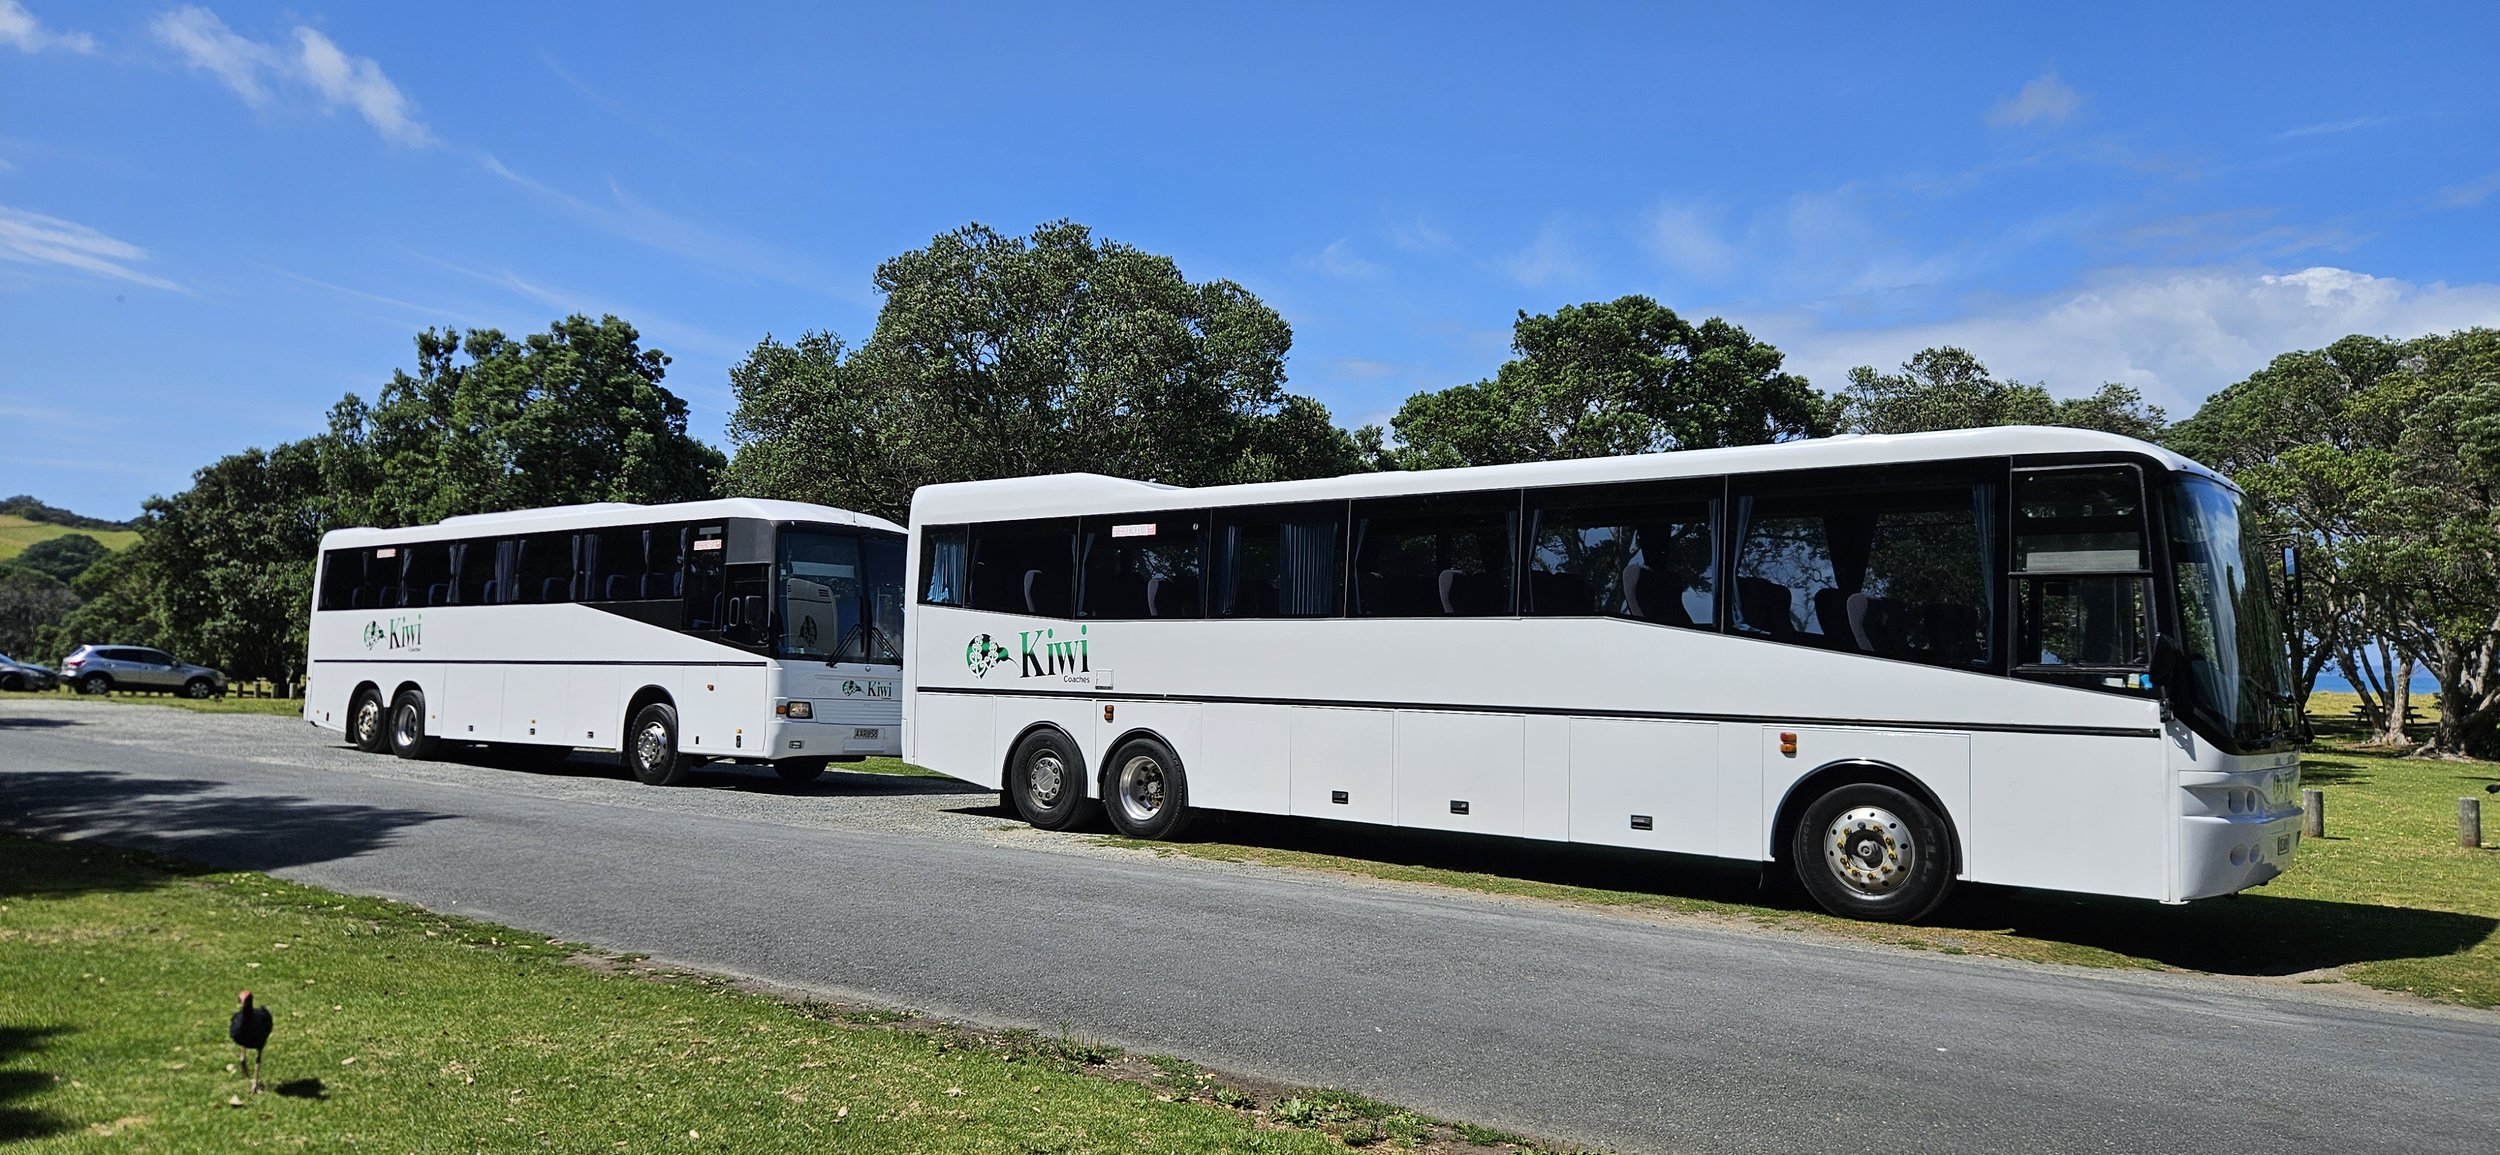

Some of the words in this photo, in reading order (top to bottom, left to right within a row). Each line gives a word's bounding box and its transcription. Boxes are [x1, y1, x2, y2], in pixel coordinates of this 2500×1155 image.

[389, 613, 421, 650] Kiwi
[1018, 624, 1091, 679] Kiwi
[866, 680, 892, 697] Kiwi
[1063, 675, 1091, 684] Coaches
